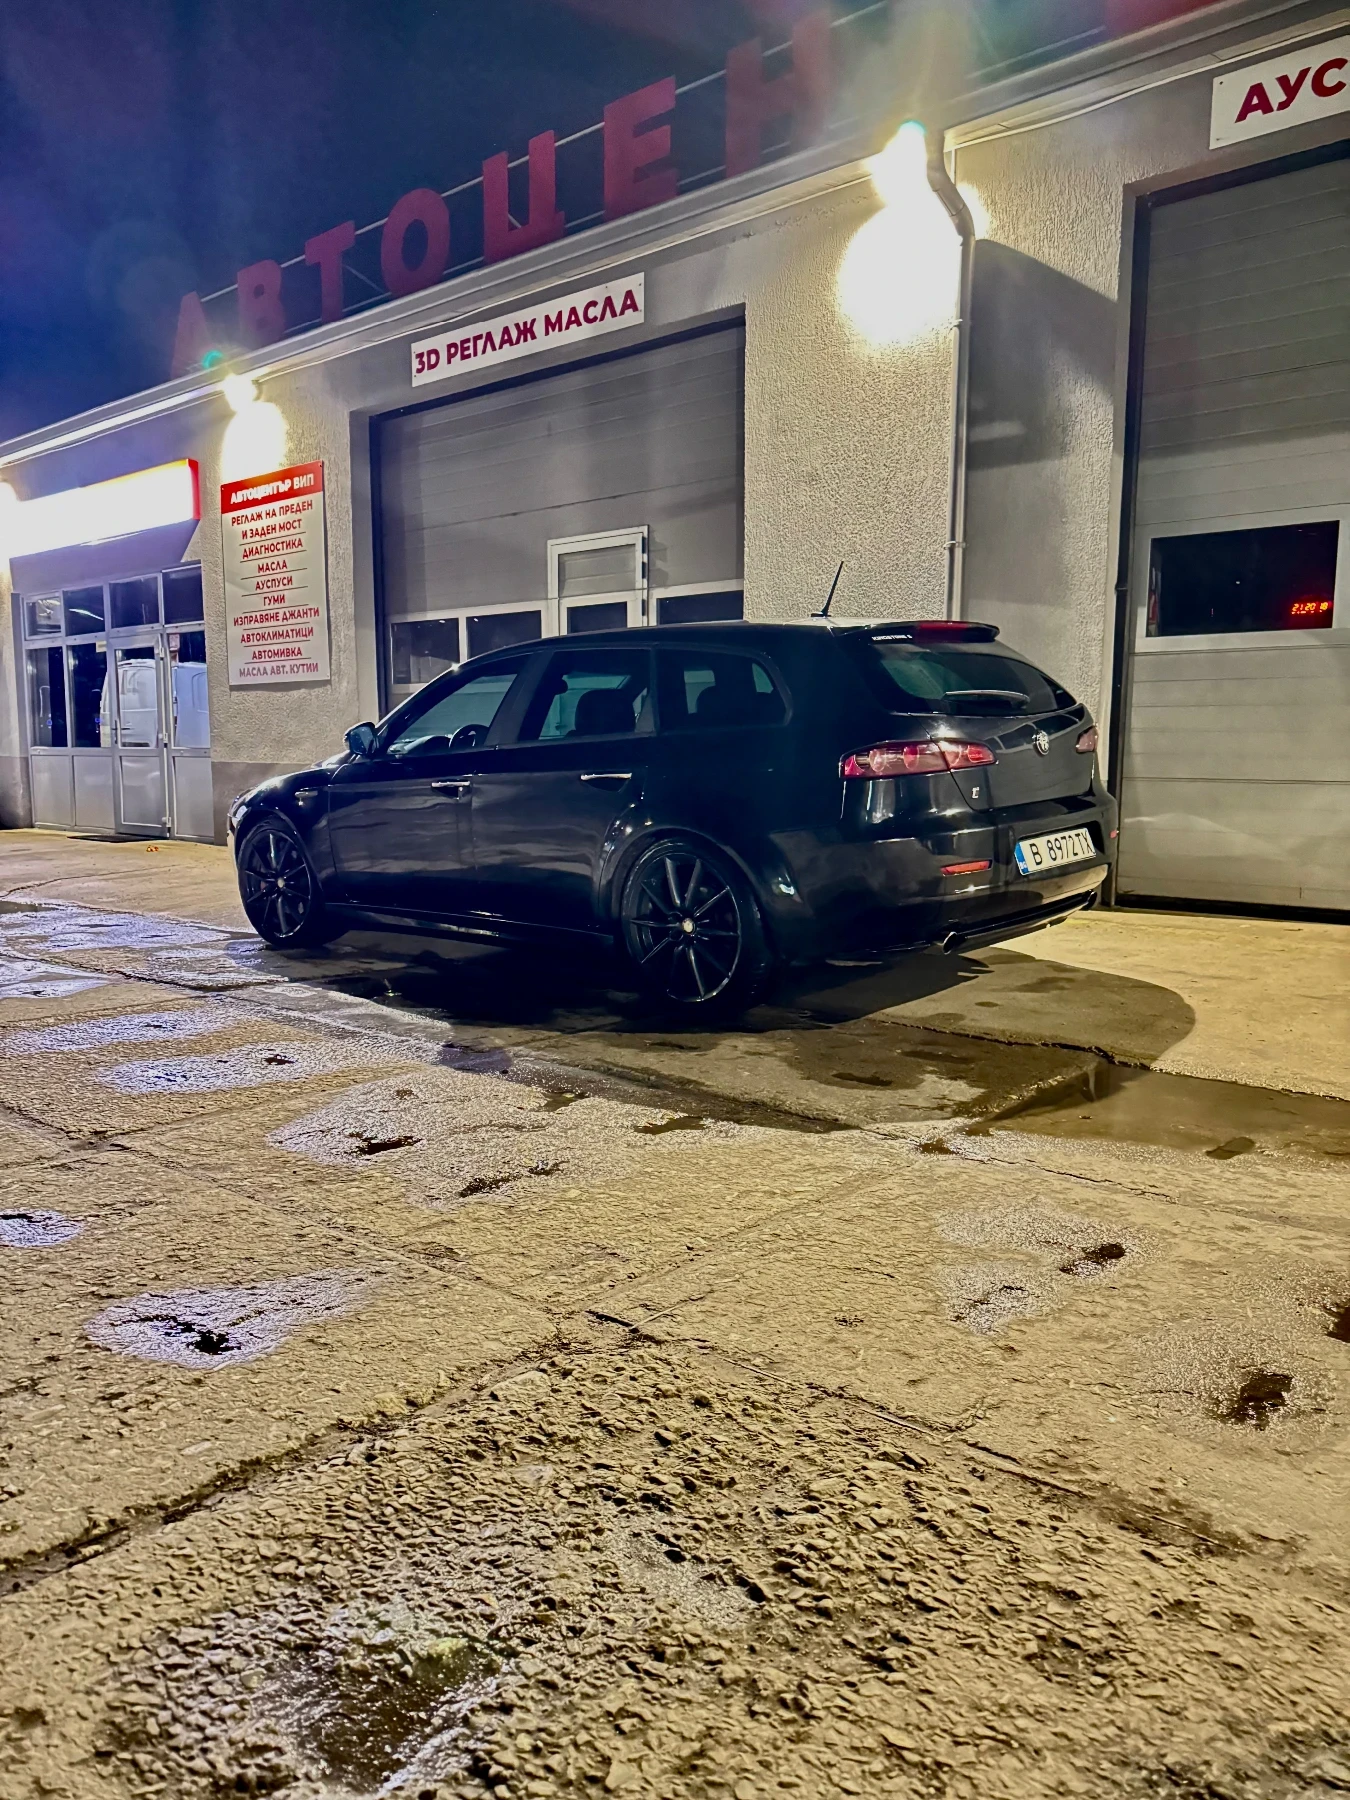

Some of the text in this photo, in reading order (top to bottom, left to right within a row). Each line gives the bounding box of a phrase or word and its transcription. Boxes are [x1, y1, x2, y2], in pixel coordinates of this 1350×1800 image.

[1234, 57, 1349, 124] АУС
[170, 8, 832, 379] АВТОЦЕН
[415, 289, 639, 374] 3D РЕГЛАЖ МАСЛА
[293, 473, 315, 489] ВИП
[231, 500, 313, 526] РЕГЛАЖ НА ПРЕДЕН
[241, 518, 302, 540] И ЗАДЕН МОСТ
[242, 537, 304, 560] ДИАГНОСТИКА
[257, 559, 288, 574] МАСЛА
[255, 575, 293, 591] АУСПУСИ
[263, 594, 286, 606] ГУМИ
[233, 607, 320, 627] ИЗПРАВЯНЕ ДЖАНТИ
[240, 627, 314, 643] АВТОКЛИМАТИЦИ
[251, 647, 303, 660] АВТОМИВКА
[239, 662, 319, 678] МАСЛА АВТ. КУТИИ
